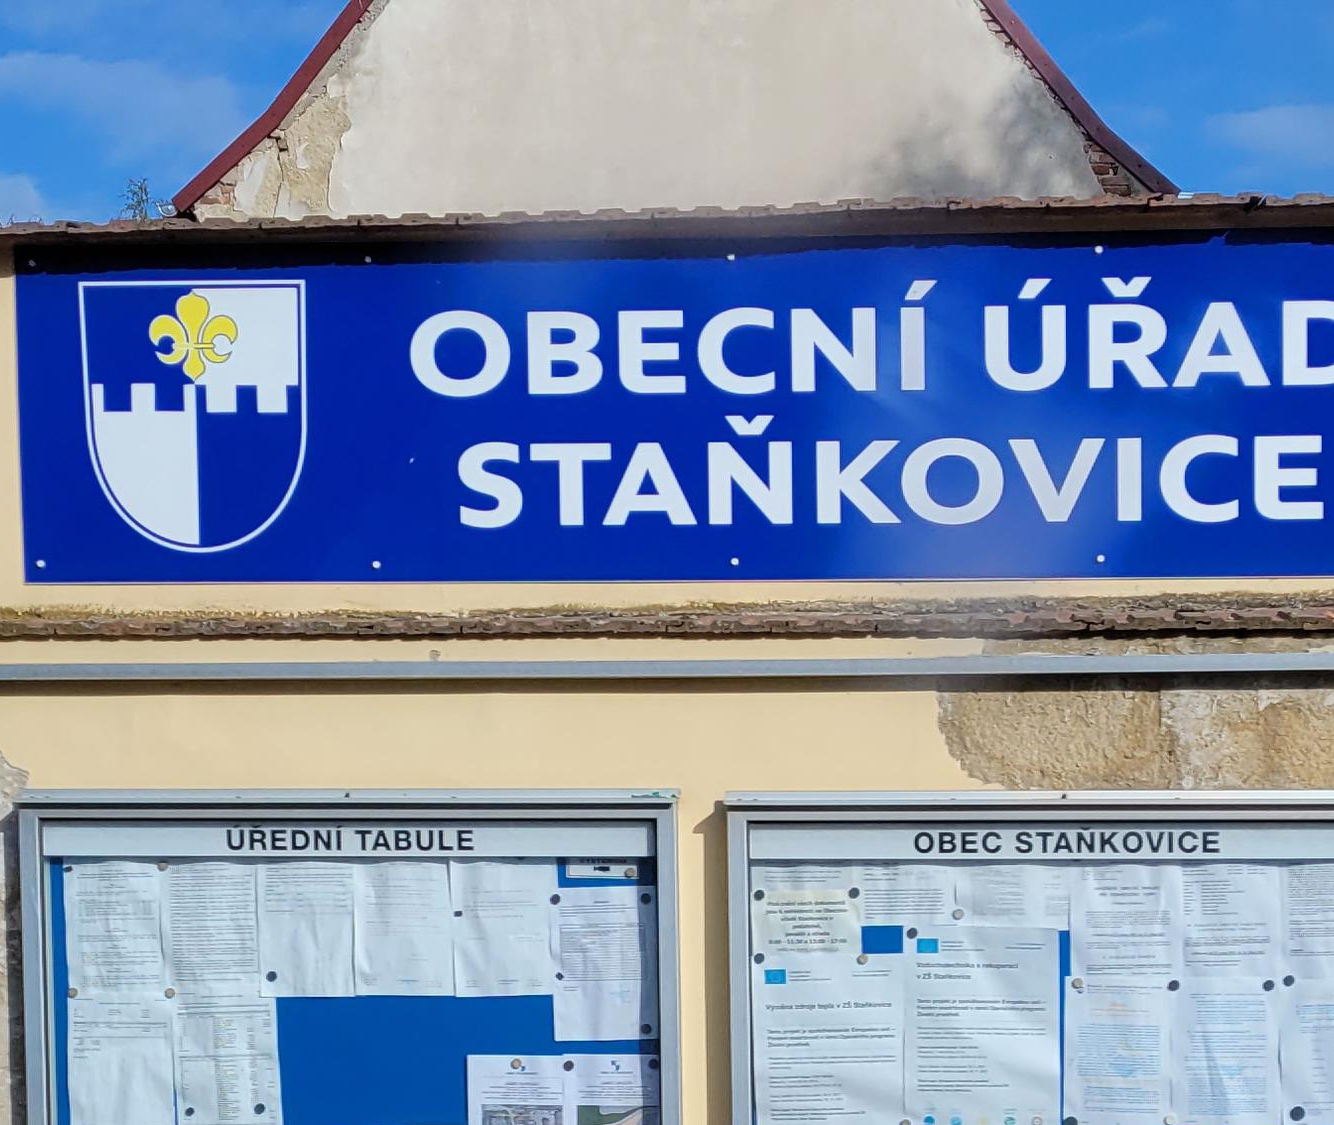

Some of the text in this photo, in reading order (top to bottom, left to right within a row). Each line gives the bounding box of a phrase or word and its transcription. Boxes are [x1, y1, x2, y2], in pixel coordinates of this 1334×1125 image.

[410, 278, 938, 398] OBECNÍ
[457, 413, 1325, 529] STAŇKOVICE
[226, 825, 475, 852] ÚŘEDNÍ TABULE
[913, 825, 1222, 854] OBEC STAŇKOVICE
